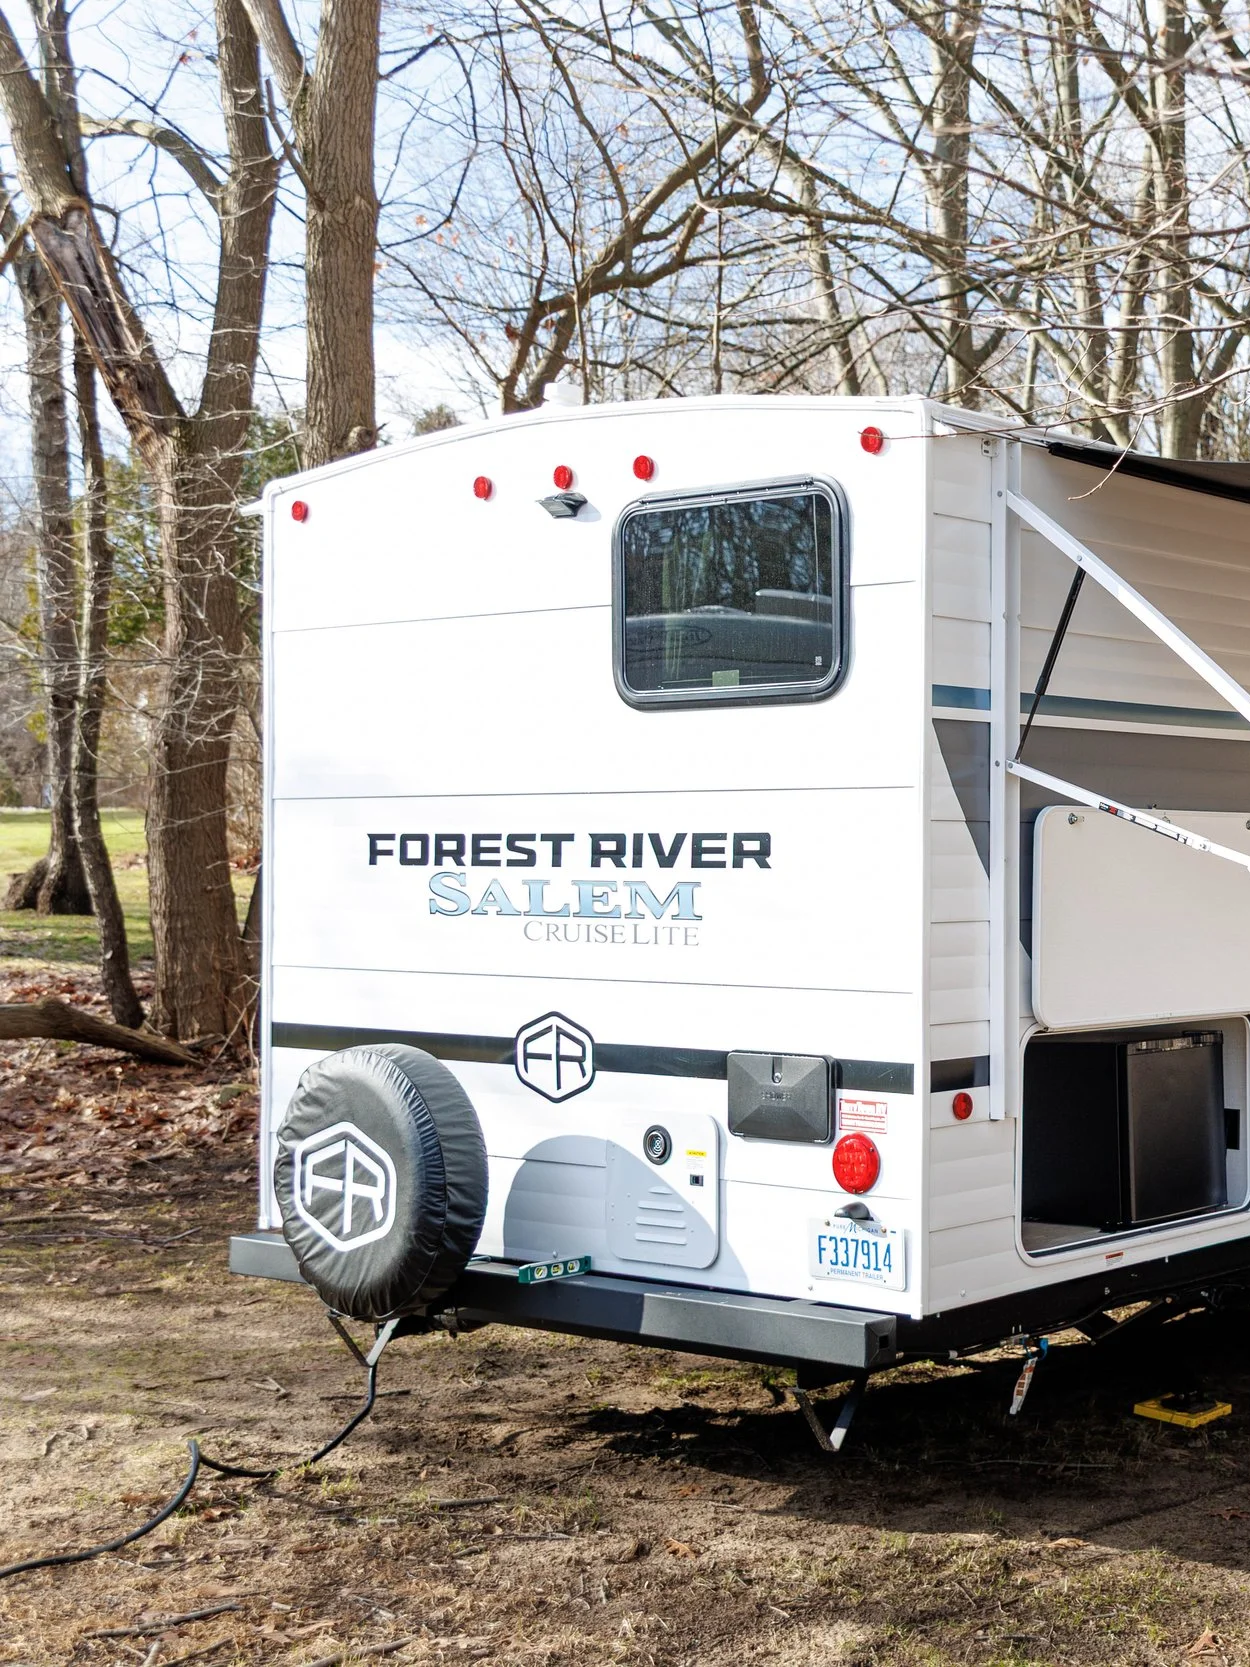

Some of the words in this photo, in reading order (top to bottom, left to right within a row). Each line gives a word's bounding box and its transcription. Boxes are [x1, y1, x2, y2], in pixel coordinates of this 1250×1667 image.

[366, 833, 575, 867] FOREST
[588, 832, 772, 869] RIVER
[428, 871, 703, 921] SALEM
[818, 1235, 892, 1273] F337914
[830, 1268, 861, 1277] PERMANENT
[862, 1272, 884, 1281] TRAILER
